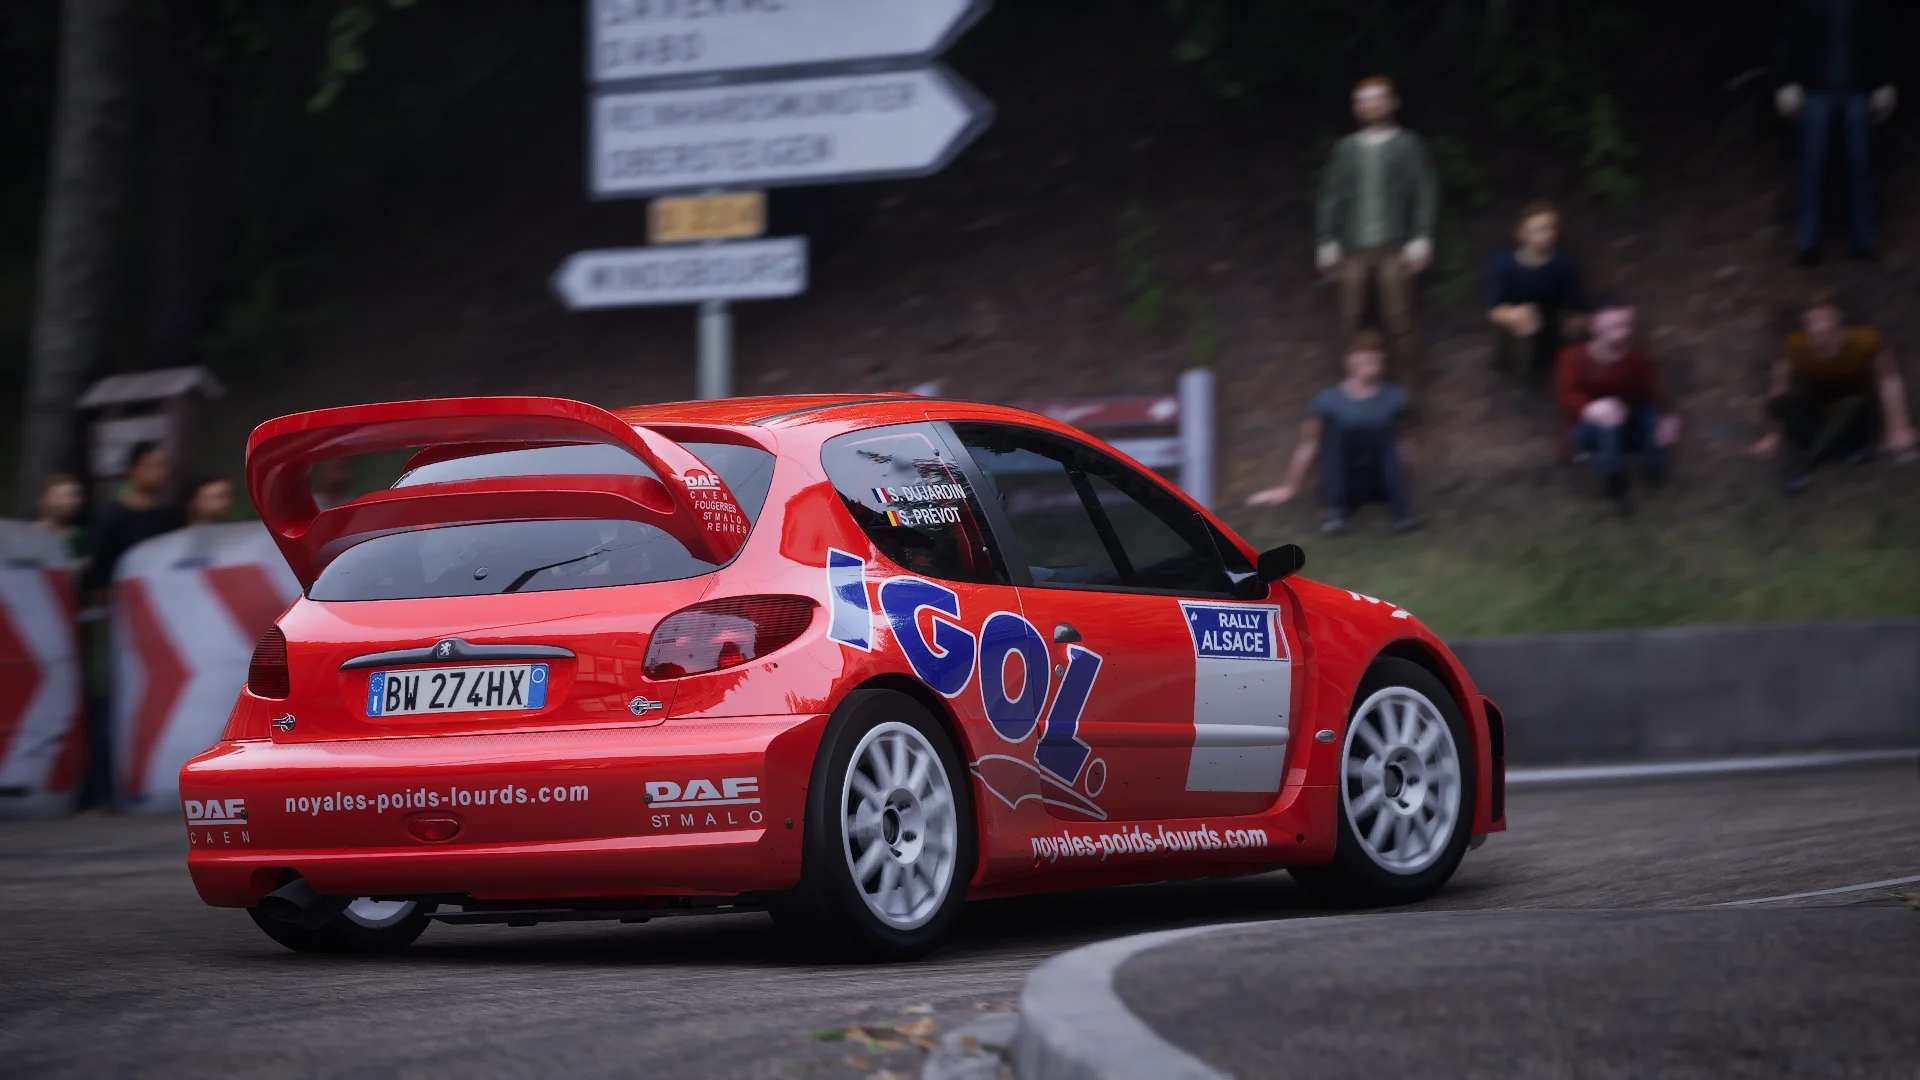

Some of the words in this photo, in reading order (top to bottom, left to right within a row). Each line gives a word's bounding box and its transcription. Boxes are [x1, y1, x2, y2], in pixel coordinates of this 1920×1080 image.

[684, 474, 720, 487] DAF
[690, 491, 728, 500] CAEN
[887, 487, 903, 502] S.
[901, 483, 966, 501] DUJARDIN
[695, 500, 737, 513] FOUGERRES
[898, 510, 913, 525] S.
[912, 504, 961, 524] PRÉVOT
[703, 511, 712, 520] ST
[715, 512, 741, 524] MALO
[707, 522, 747, 534] RENNES
[1218, 612, 1260, 629] RALLY
[1201, 629, 1264, 653] ALSACE
[826, 547, 1102, 786] IGOL
[385, 675, 420, 712] BW
[428, 669, 526, 709] 274HX
[644, 777, 759, 802] DAF
[184, 798, 246, 820] DAF
[284, 782, 590, 817] noyales-poids-lourds.com
[651, 814, 671, 828] ST
[680, 810, 763, 827] MALO
[190, 830, 251, 844] CAEN
[1031, 823, 1268, 864] noyales-poids-lourds.com
